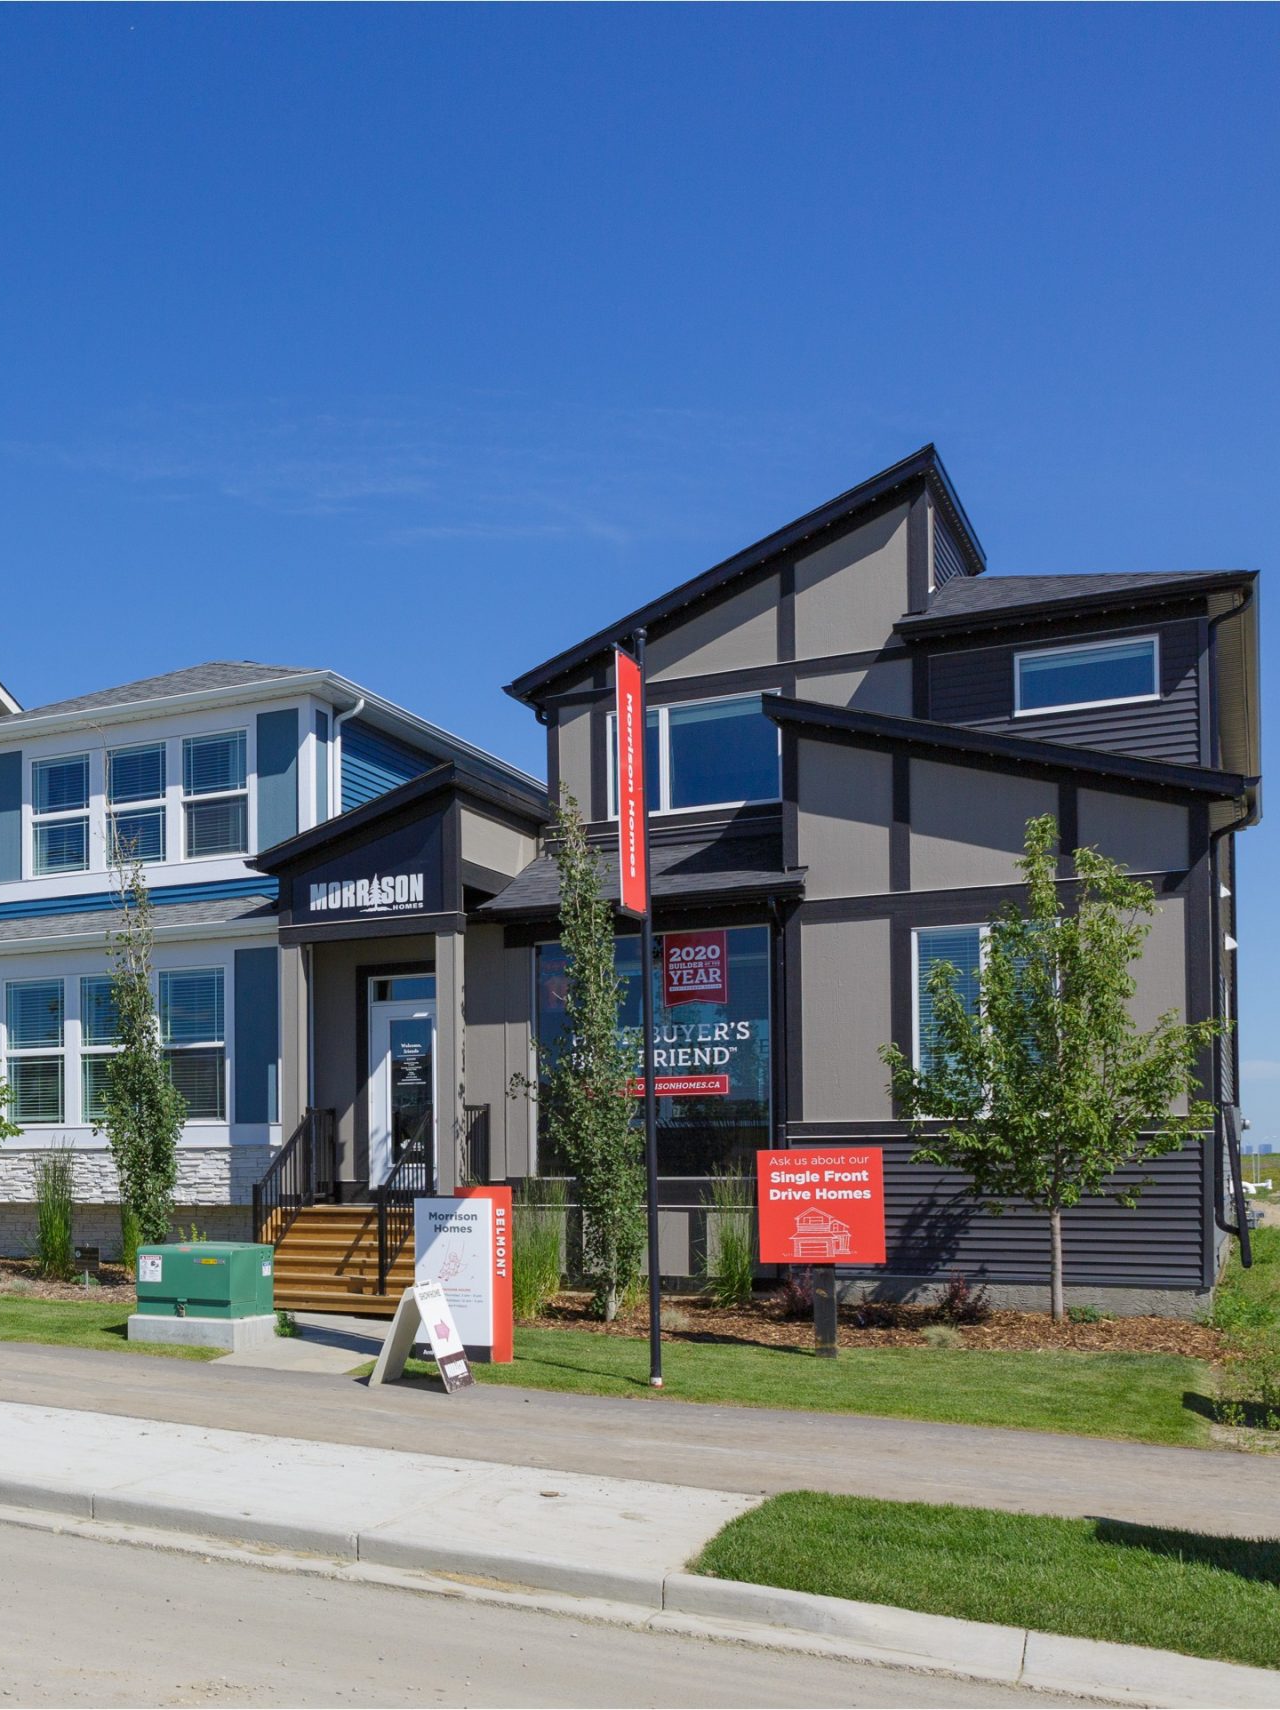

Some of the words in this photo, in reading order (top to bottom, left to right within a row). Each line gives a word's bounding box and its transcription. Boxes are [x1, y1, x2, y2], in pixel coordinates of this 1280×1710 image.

[626, 693, 634, 793] Morrison
[628, 800, 636, 878] Homes
[310, 873, 424, 911] MORRISON
[392, 902, 424, 910] HOMES
[669, 944, 721, 962] 2020
[669, 961, 704, 969] BUILDER
[669, 968, 722, 985] YEAR
[769, 1156, 791, 1166] Ask
[794, 1157, 808, 1166] us
[811, 1155, 846, 1165] about
[848, 1156, 869, 1165] our
[770, 1170, 820, 1185] Single
[824, 1170, 869, 1182] Front
[769, 1188, 811, 1200] Drive
[815, 1188, 872, 1200] Homes
[428, 1211, 478, 1221] Morrison
[434, 1224, 473, 1234] Homes
[495, 1208, 506, 1277] BELMONT
